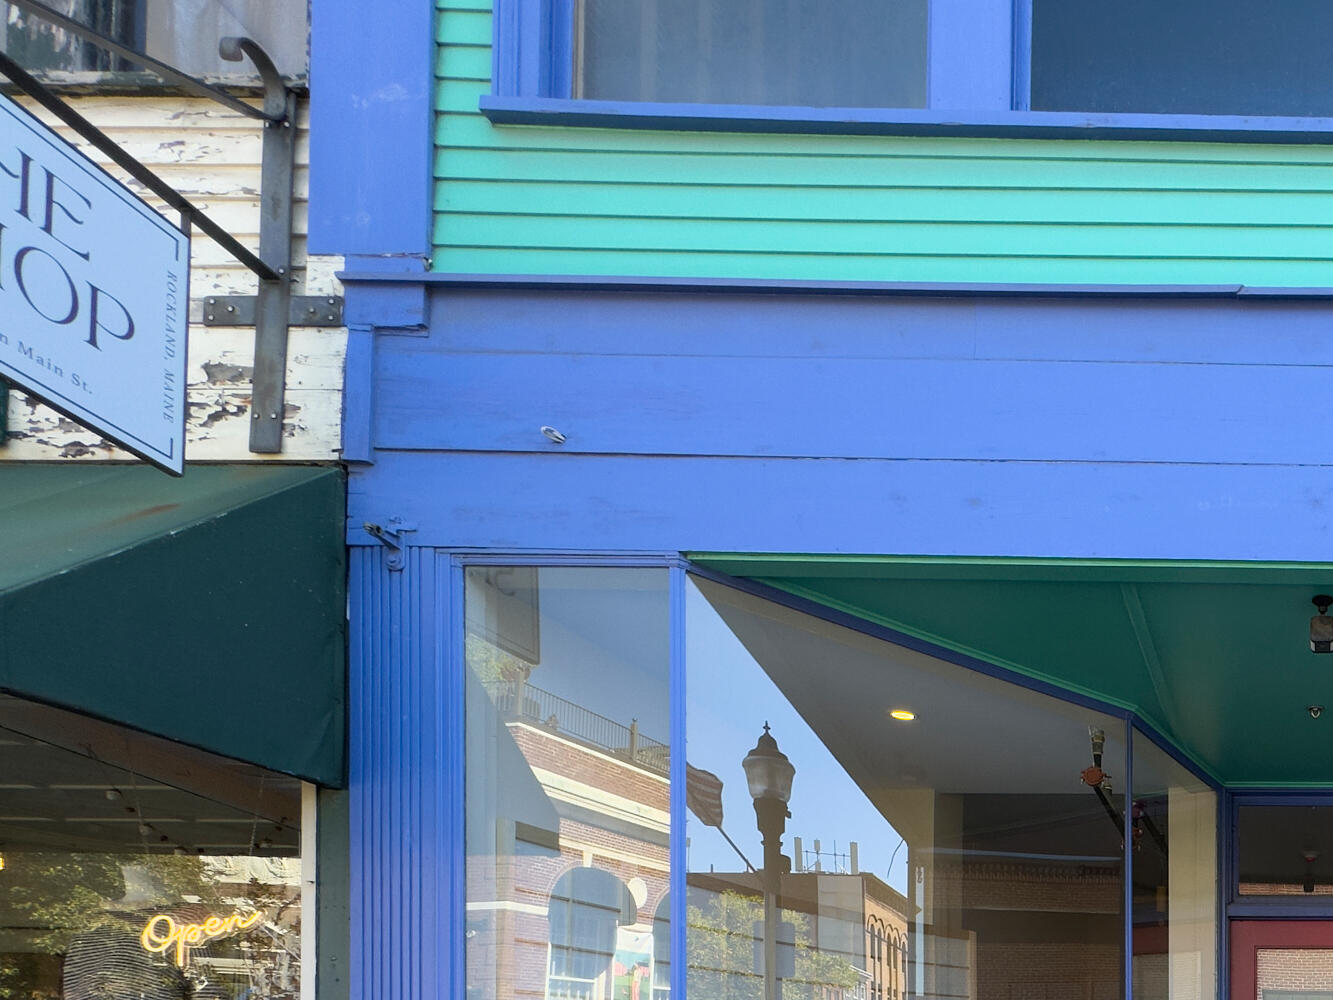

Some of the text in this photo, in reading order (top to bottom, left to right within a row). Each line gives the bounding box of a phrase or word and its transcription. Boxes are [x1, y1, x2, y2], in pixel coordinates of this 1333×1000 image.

[0, 222, 135, 352] OP
[17, 340, 64, 378] Main
[71, 372, 94, 395] St.
[163, 270, 178, 424] ROCKLAND, MAINE
[141, 908, 267, 967] Open
